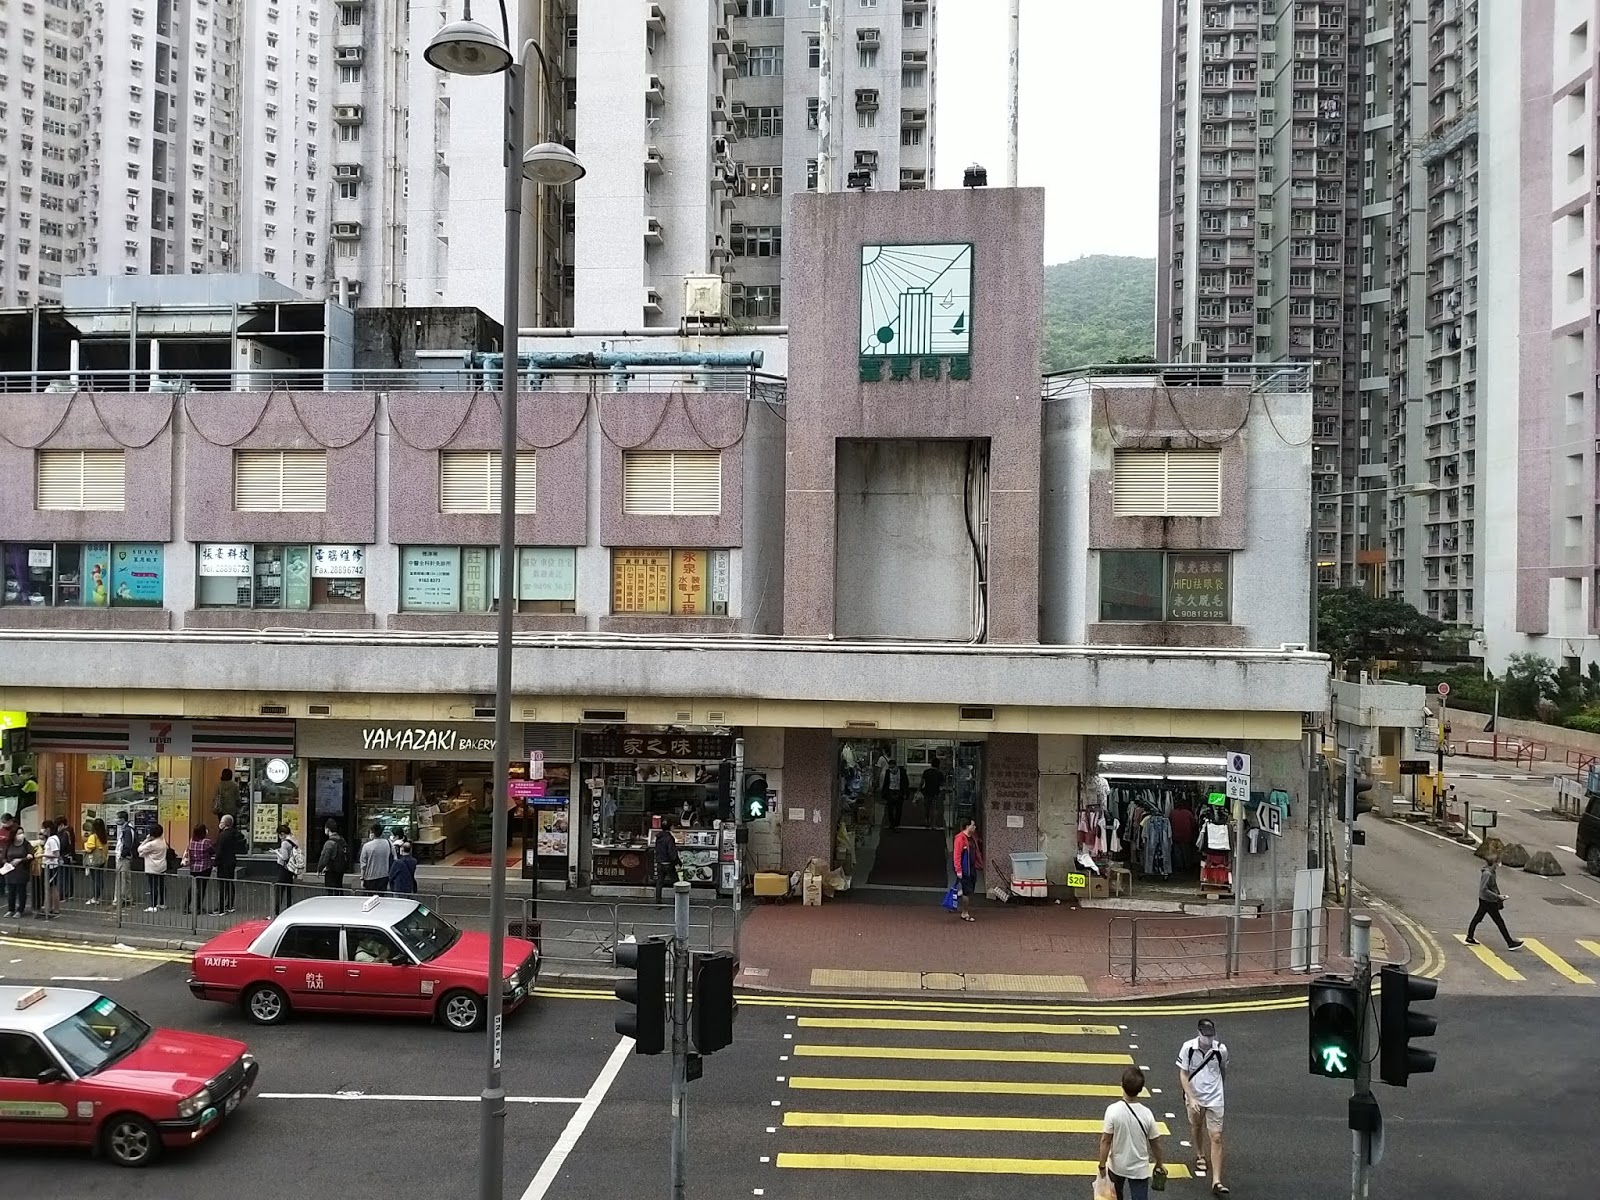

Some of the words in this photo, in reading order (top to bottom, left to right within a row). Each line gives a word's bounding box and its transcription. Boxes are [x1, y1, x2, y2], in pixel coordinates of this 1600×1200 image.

[314, 549, 363, 562] 電腦維修
[683, 551, 696, 574] 永泉
[679, 576, 687, 592] 水電
[691, 576, 700, 592] 裝修
[682, 593, 696, 615] 工程
[150, 722, 171, 752] 7
[362, 727, 457, 751] YAMAZAKI
[459, 738, 497, 750] BAKERY
[623, 738, 692, 756] 家之味
[1229, 775, 1237, 783] 24
[1238, 778, 1248, 786] hrs
[1230, 786, 1246, 798] 全日
[1270, 809, 1280, 829] P
[1069, 876, 1084, 885] $20
[305, 973, 323, 981] 的士
[306, 980, 324, 989] TAXI
